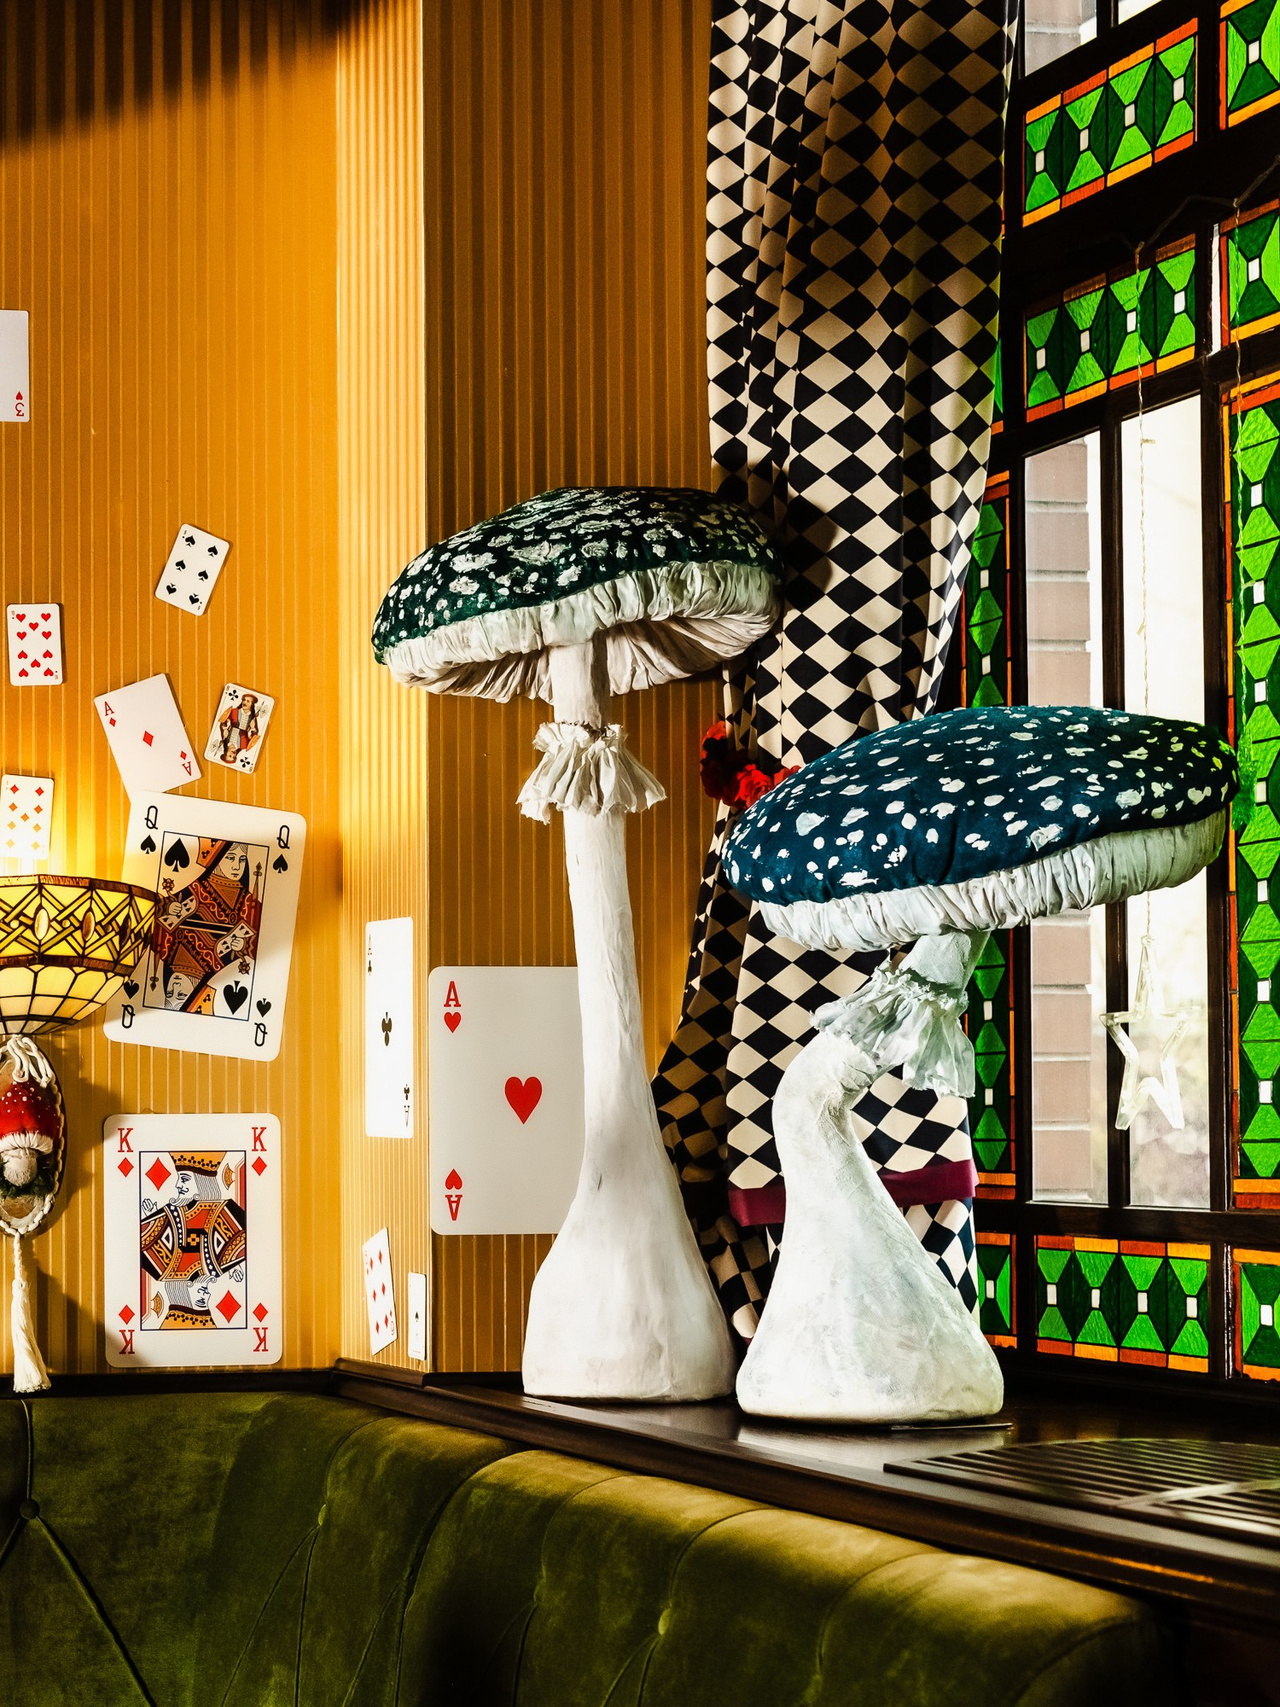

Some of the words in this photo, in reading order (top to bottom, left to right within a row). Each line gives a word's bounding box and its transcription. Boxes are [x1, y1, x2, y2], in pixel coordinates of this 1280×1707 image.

[15, 402, 24, 417] 3
[104, 701, 115, 716] A
[182, 761, 192, 776] A
[144, 805, 158, 830] Q
[276, 825, 290, 850] Q
[443, 980, 462, 1007] A
[121, 1003, 135, 1029] Q
[254, 1022, 268, 1047] Q
[117, 1128, 134, 1153] K
[251, 1127, 267, 1152] K
[445, 1194, 463, 1221] A
[119, 1329, 135, 1355] K
[253, 1327, 268, 1352] K
